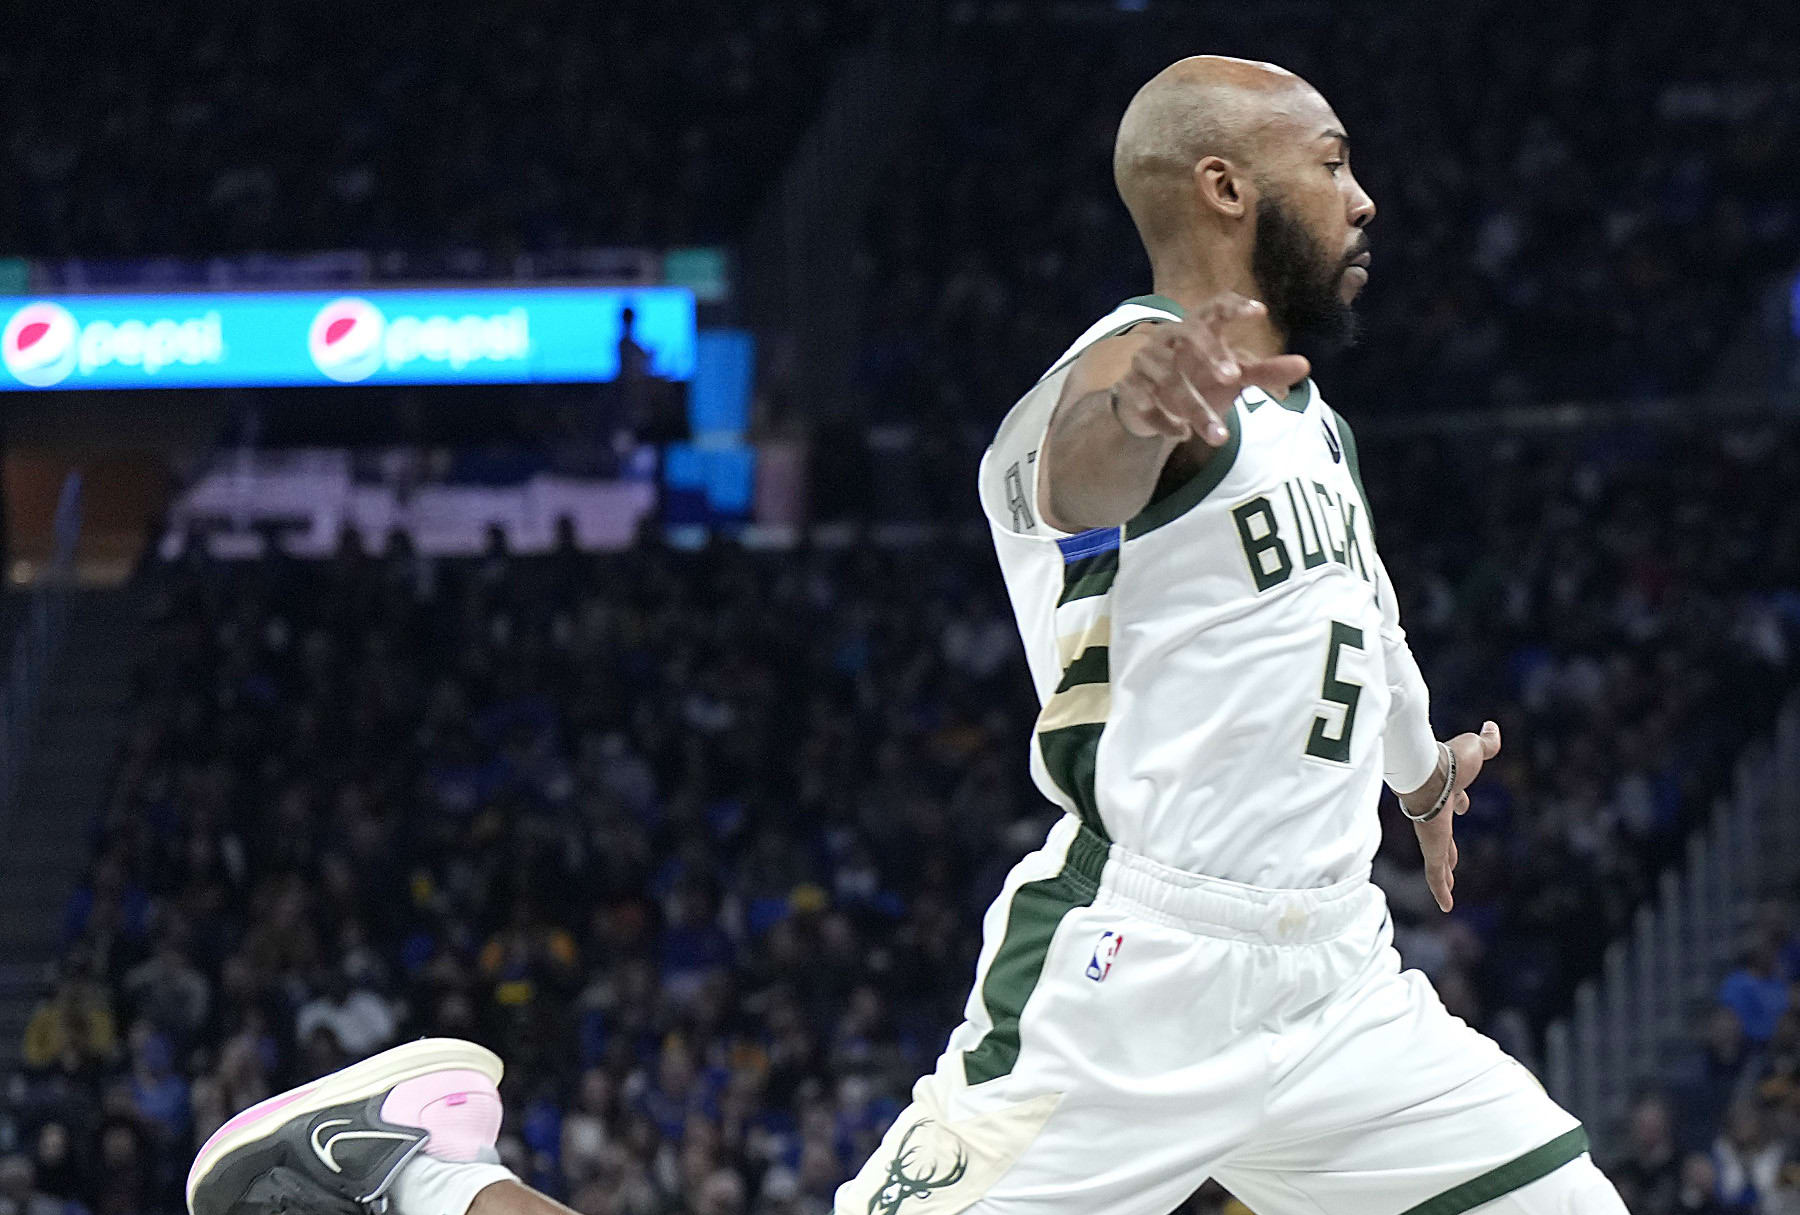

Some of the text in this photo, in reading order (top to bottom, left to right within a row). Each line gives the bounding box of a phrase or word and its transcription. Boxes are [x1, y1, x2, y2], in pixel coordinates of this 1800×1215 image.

[80, 310, 222, 375] pepsi
[383, 306, 529, 370] pepsi
[1231, 477, 1381, 611] BUCK
[1303, 619, 1364, 768] 5
